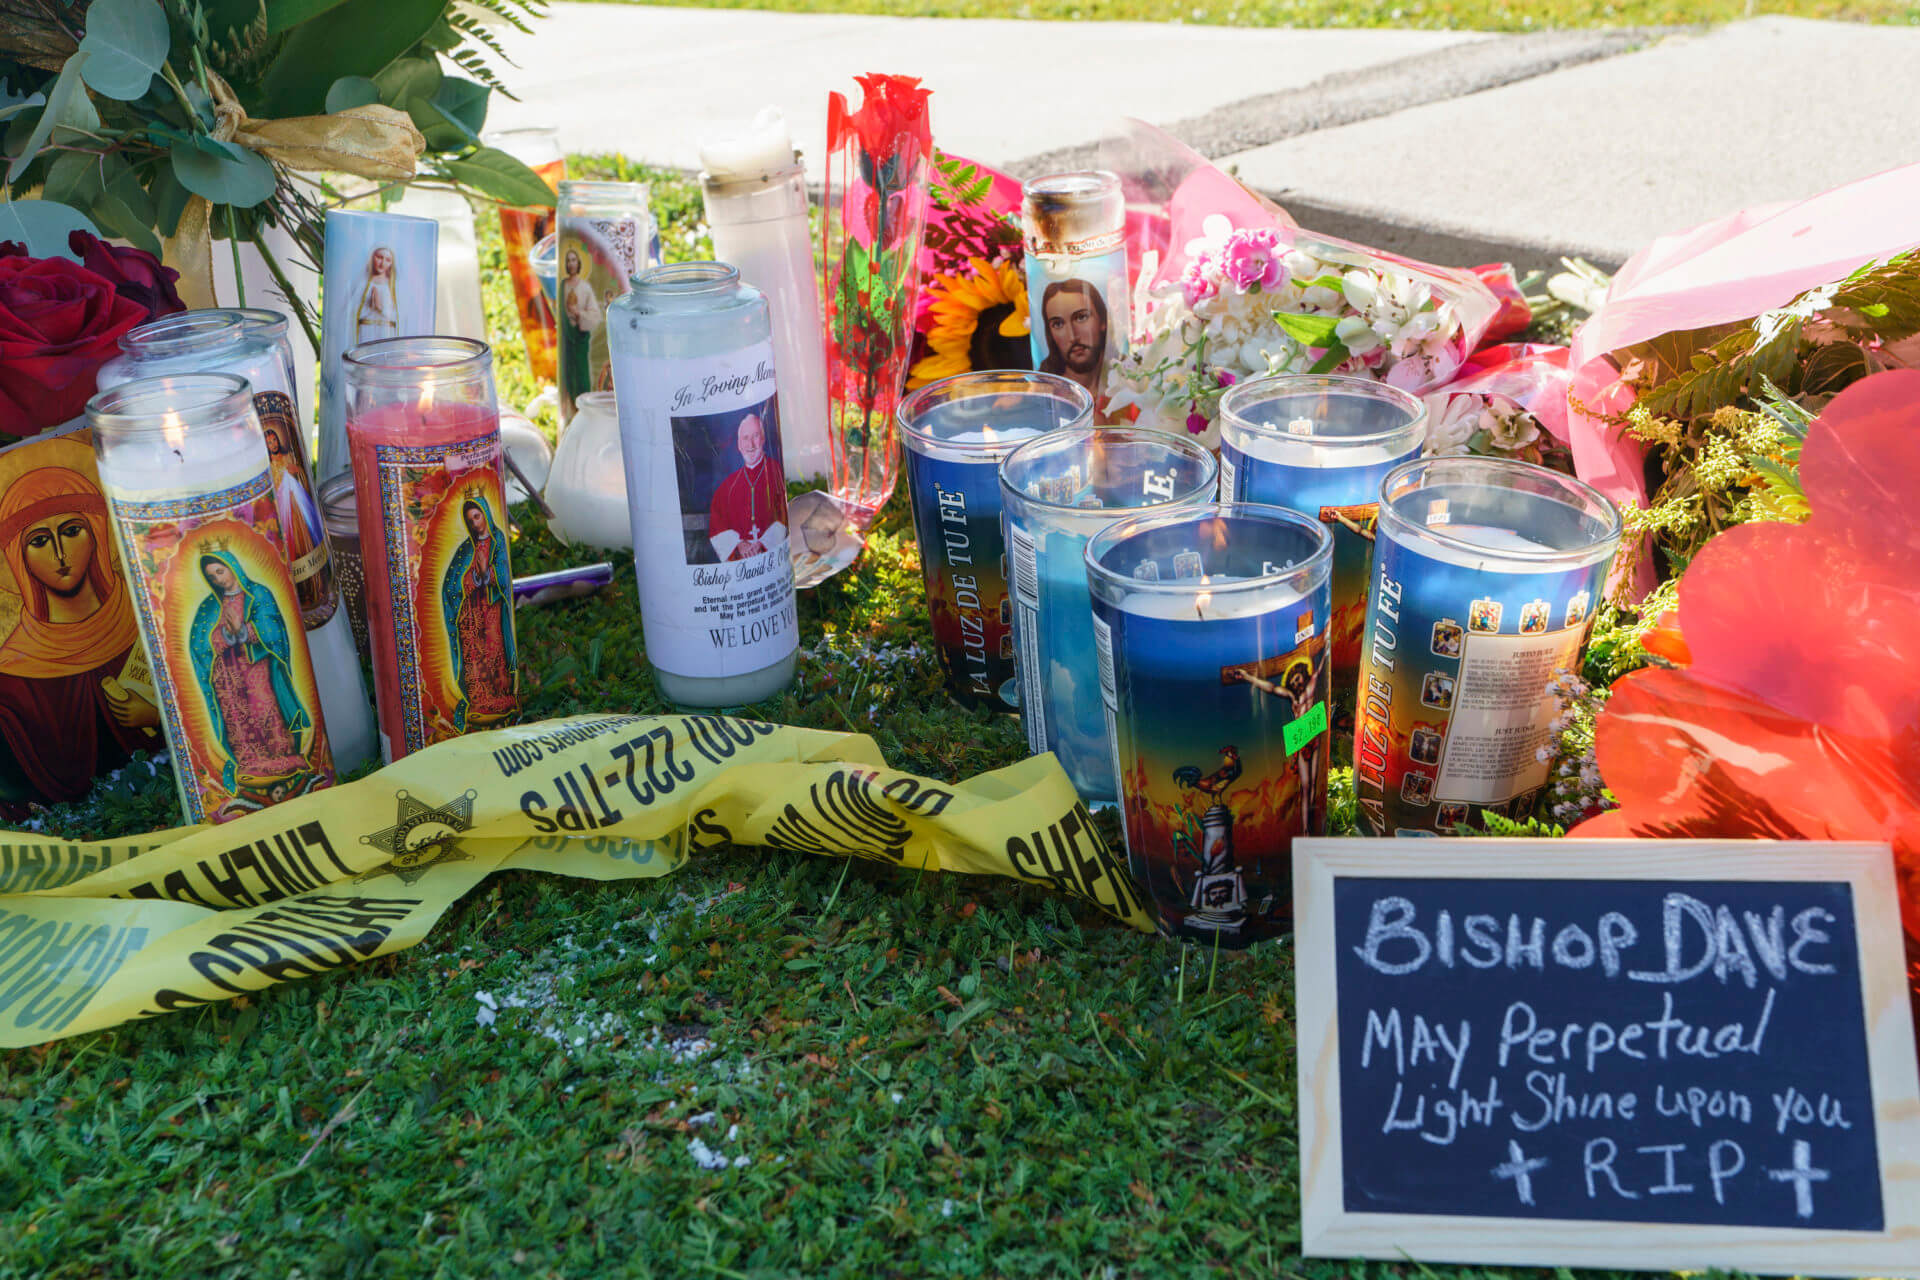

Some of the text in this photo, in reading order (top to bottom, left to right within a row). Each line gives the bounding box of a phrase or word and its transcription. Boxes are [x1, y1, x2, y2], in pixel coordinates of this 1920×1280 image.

[697, 375, 748, 402] Loving
[943, 528, 973, 567] TU
[693, 567, 731, 590] Bishop
[736, 561, 765, 582] David
[702, 594, 727, 604] Eternal
[730, 593, 744, 601] rest
[952, 574, 981, 611] DE
[720, 612, 734, 621] May
[736, 595, 765, 610] perpetual
[709, 627, 737, 648] WE
[742, 614, 779, 646] LOVE
[959, 614, 987, 665] LUZ
[1371, 620, 1398, 672] TU
[1364, 673, 1392, 729] DE
[520, 726, 695, 832] 222-TIPS
[1360, 723, 1389, 794] LUZ
[196, 820, 363, 909] LINEA
[1353, 892, 1838, 989] BISHOP DAVE
[1362, 987, 1776, 1090] MAY Perpetual
[1381, 1069, 1852, 1146] Light Shine upon you
